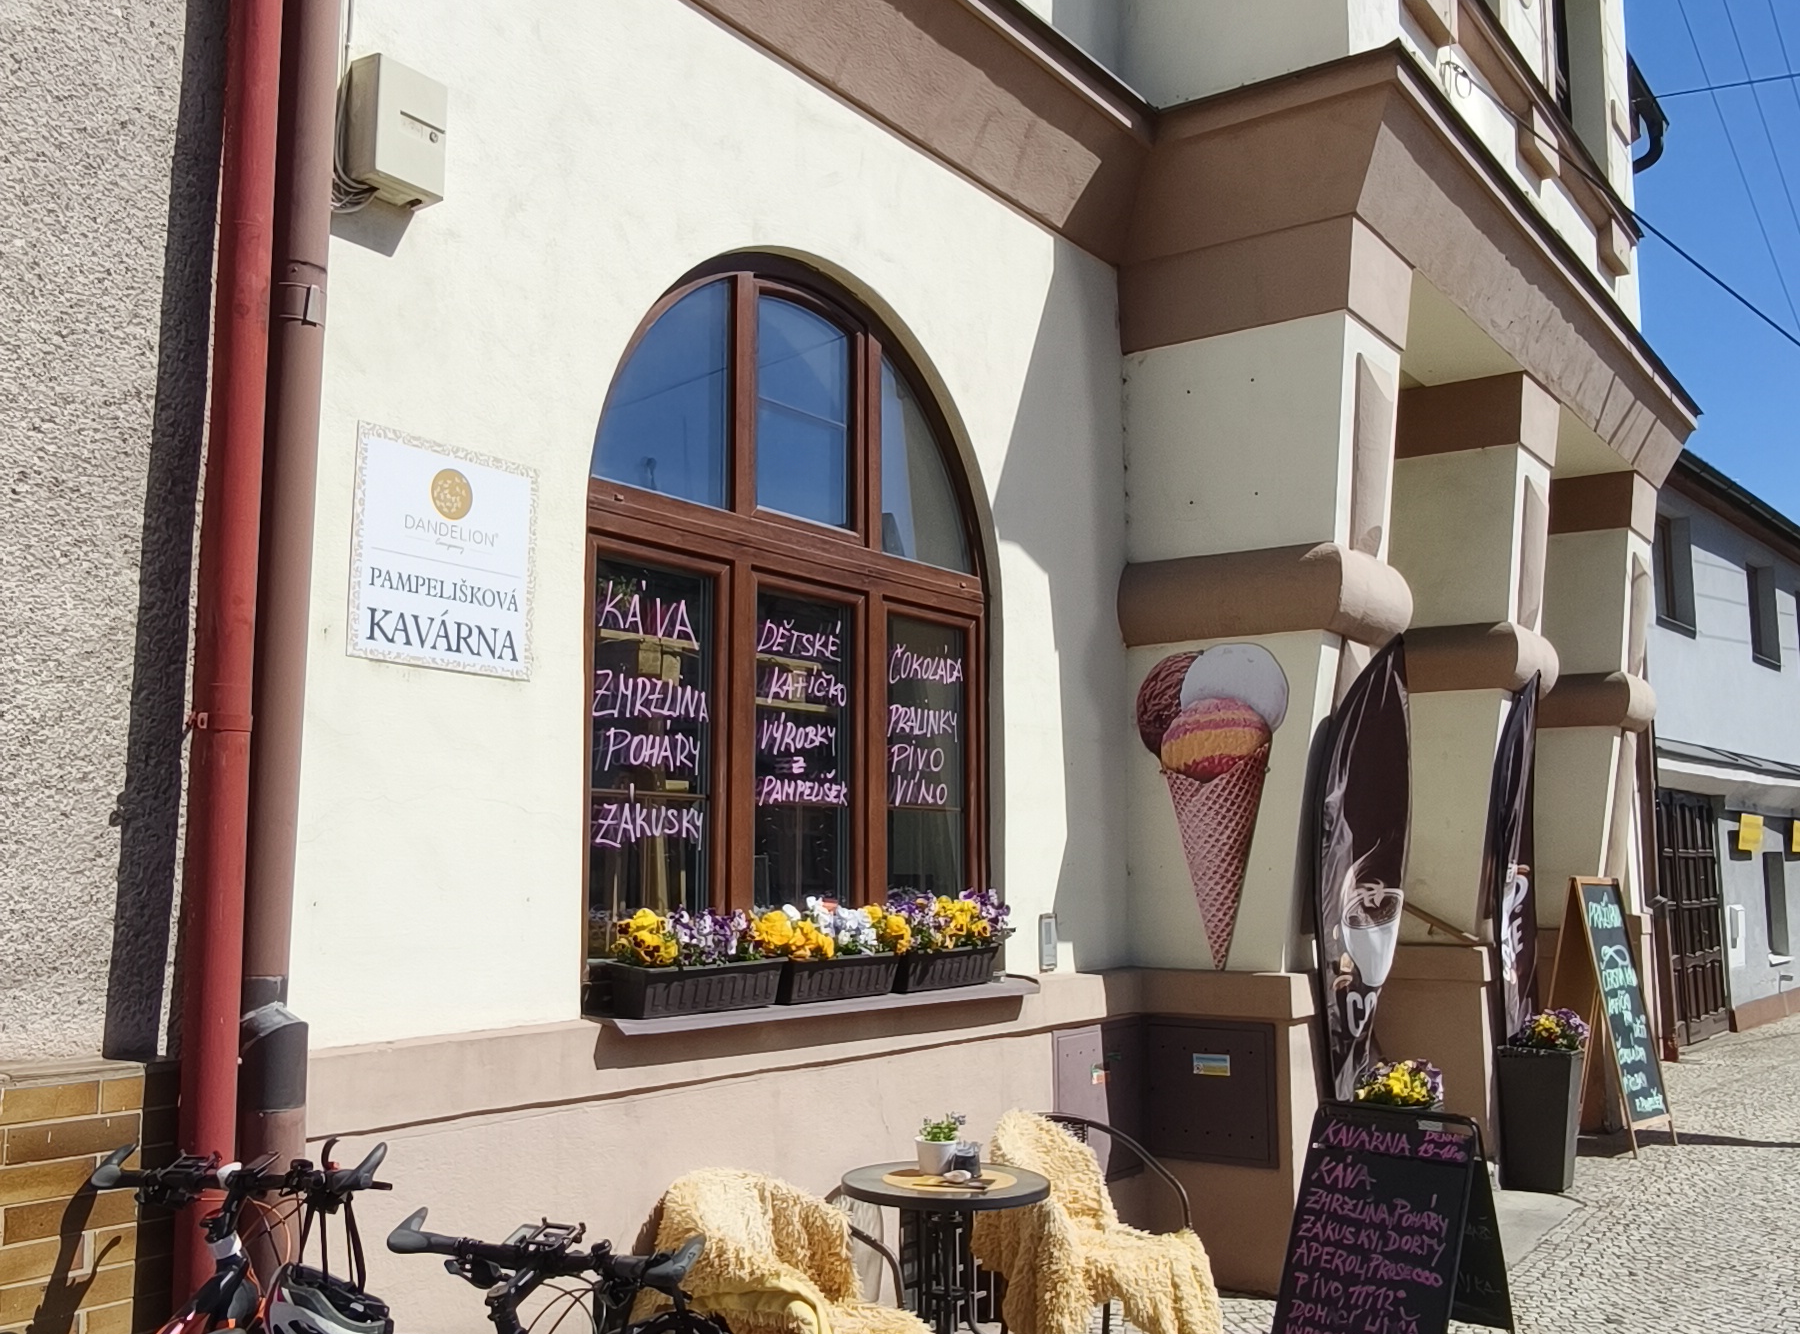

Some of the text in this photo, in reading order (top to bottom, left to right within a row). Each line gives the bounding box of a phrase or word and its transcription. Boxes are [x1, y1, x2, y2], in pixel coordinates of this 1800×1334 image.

[368, 566, 519, 612] PAMPELIŠKOVÁ
[366, 606, 519, 662] KAVÁRNA
[757, 619, 841, 662] DĚTSKÉ
[889, 643, 963, 685] ČOKOLÁDA
[592, 669, 709, 723] ZMRZLINA
[761, 711, 836, 757] VÝROBKY
[887, 700, 958, 742] PRALINKY
[604, 720, 700, 775] POHÁRY
[891, 741, 944, 773] PIVO
[758, 769, 848, 807] PAMPELIŠEK
[894, 771, 948, 806] VÍNO
[595, 783, 704, 850] ZÁKUSKY
[1318, 1119, 1411, 1157] KAVÁRNA
[1311, 1155, 1377, 1190] KÁVA
[1393, 1194, 1449, 1238] POHÁRY
[1383, 1230, 1446, 1267] DORTY
